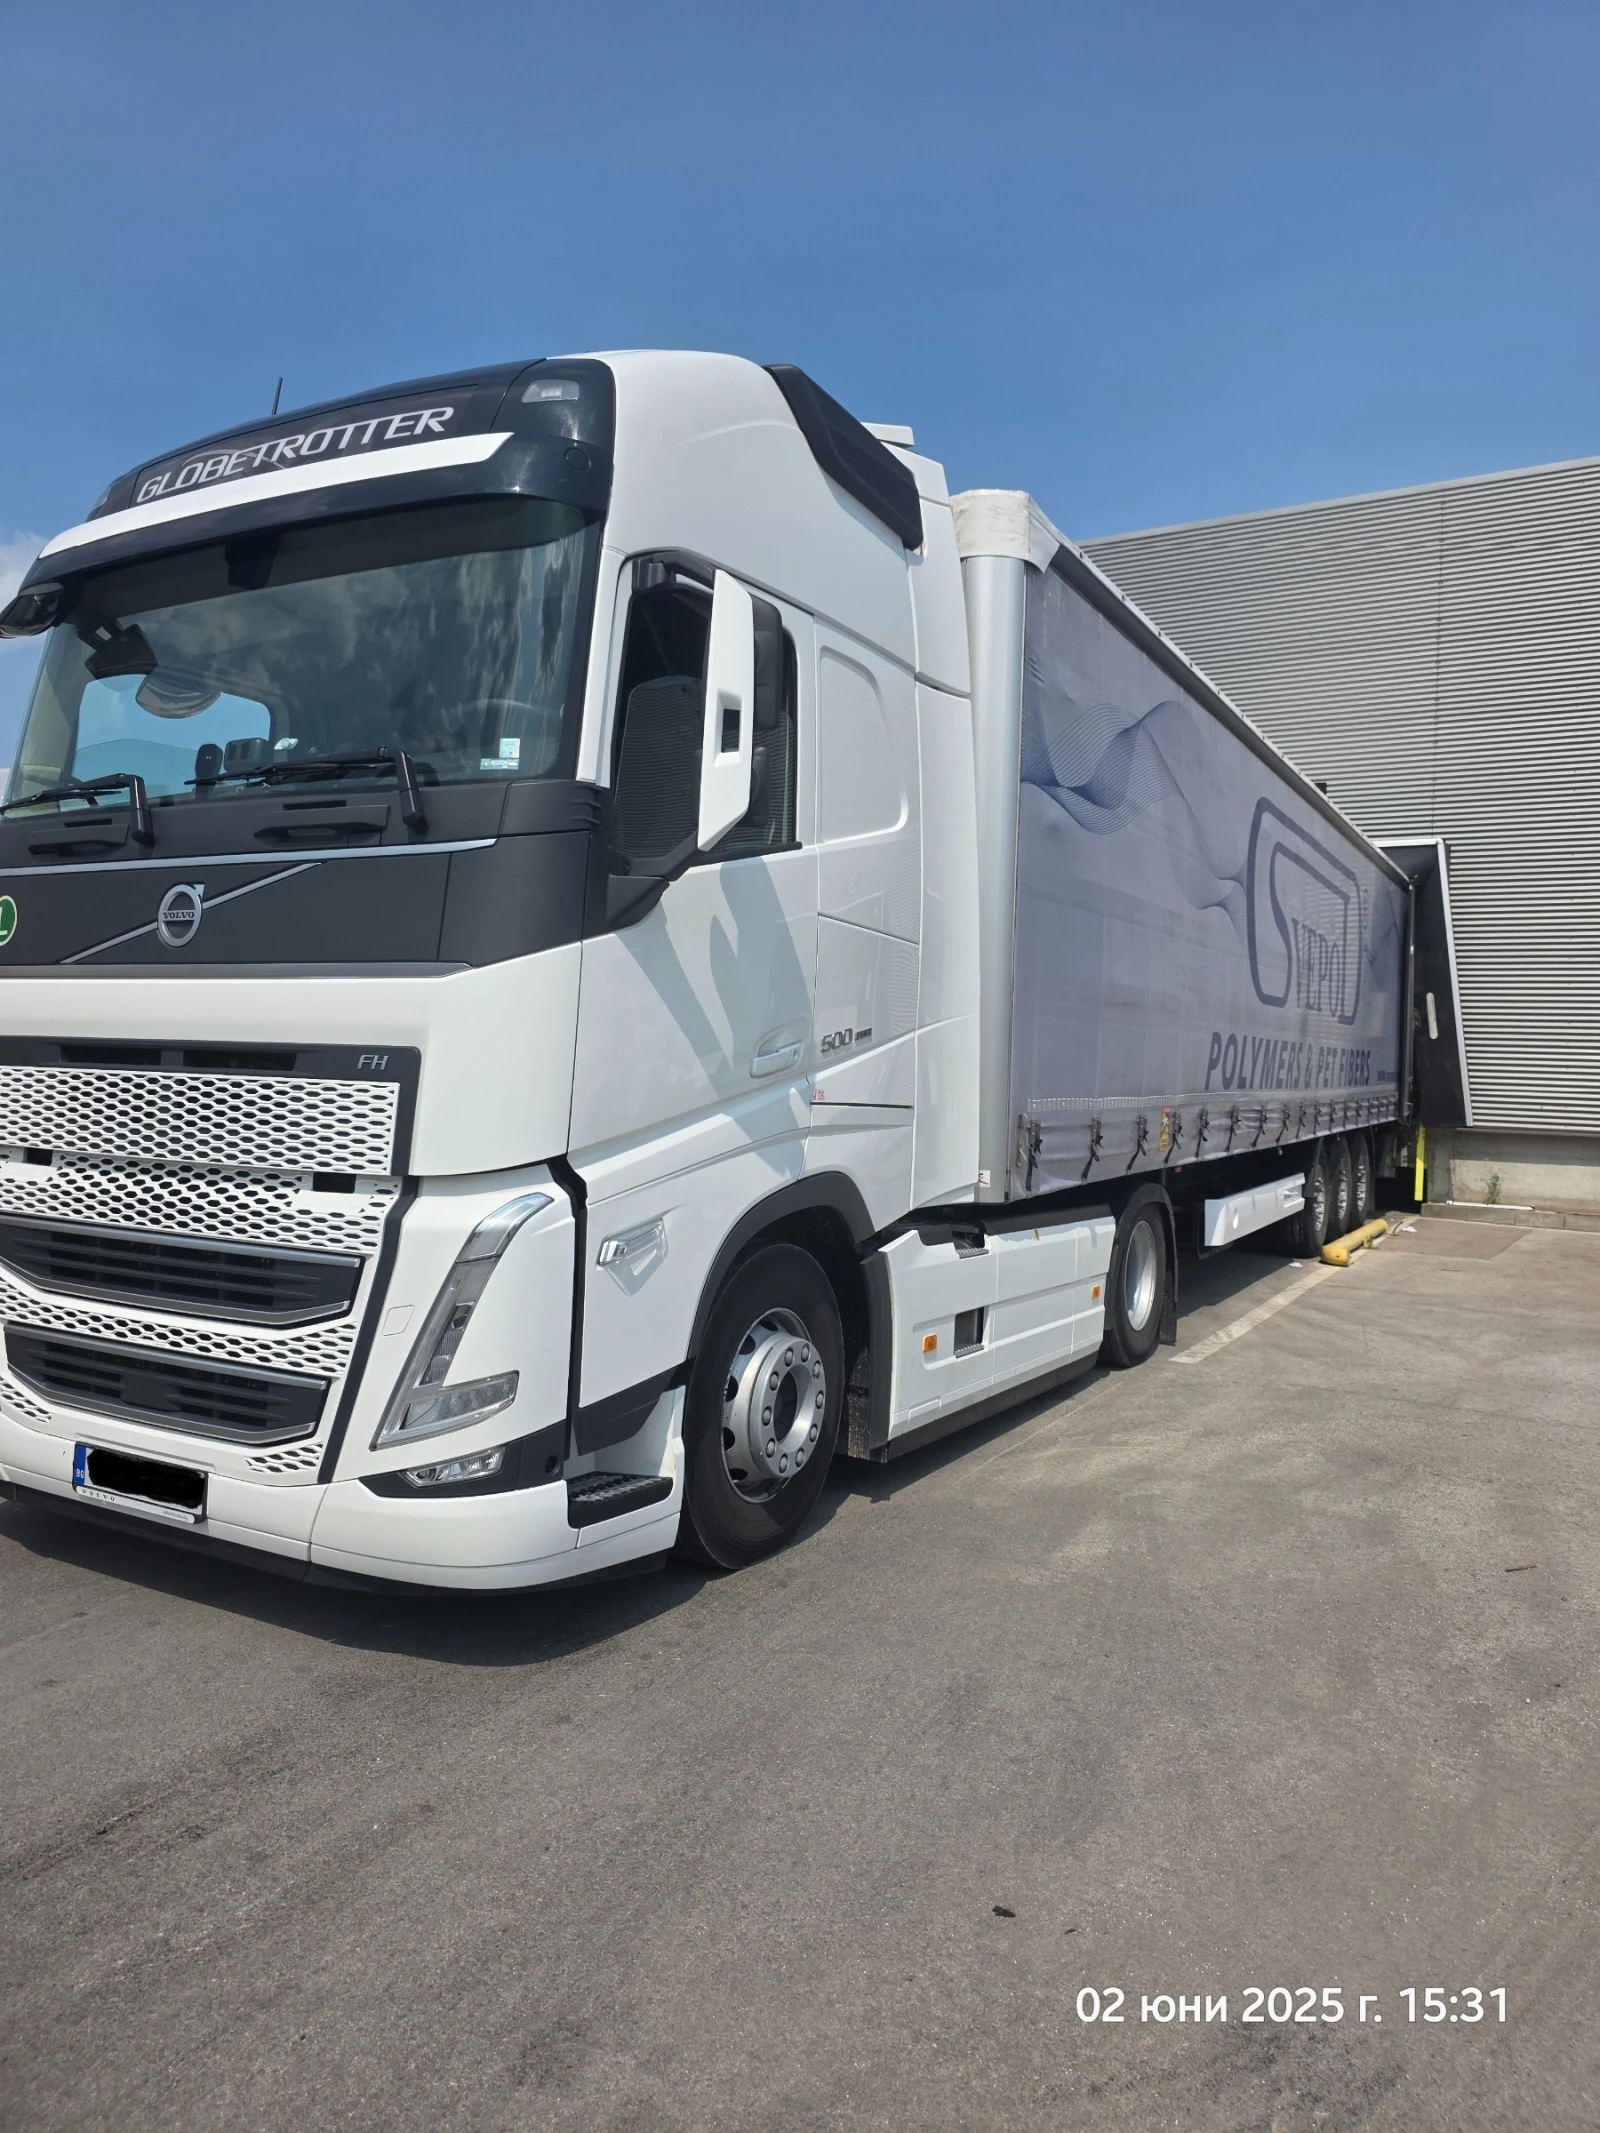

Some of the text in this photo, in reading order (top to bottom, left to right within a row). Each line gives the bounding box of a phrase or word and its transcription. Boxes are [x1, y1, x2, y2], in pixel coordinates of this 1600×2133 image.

[136, 406, 455, 503] GLOBETROTTER
[162, 911, 195, 921] VOLVO
[820, 1028, 854, 1054] 500
[357, 1054, 389, 1070] FH
[1204, 1031, 1371, 1091] POLYMERS & PET FIBERS
[76, 1468, 85, 1479] BG
[82, 1488, 115, 1502] VOLVO
